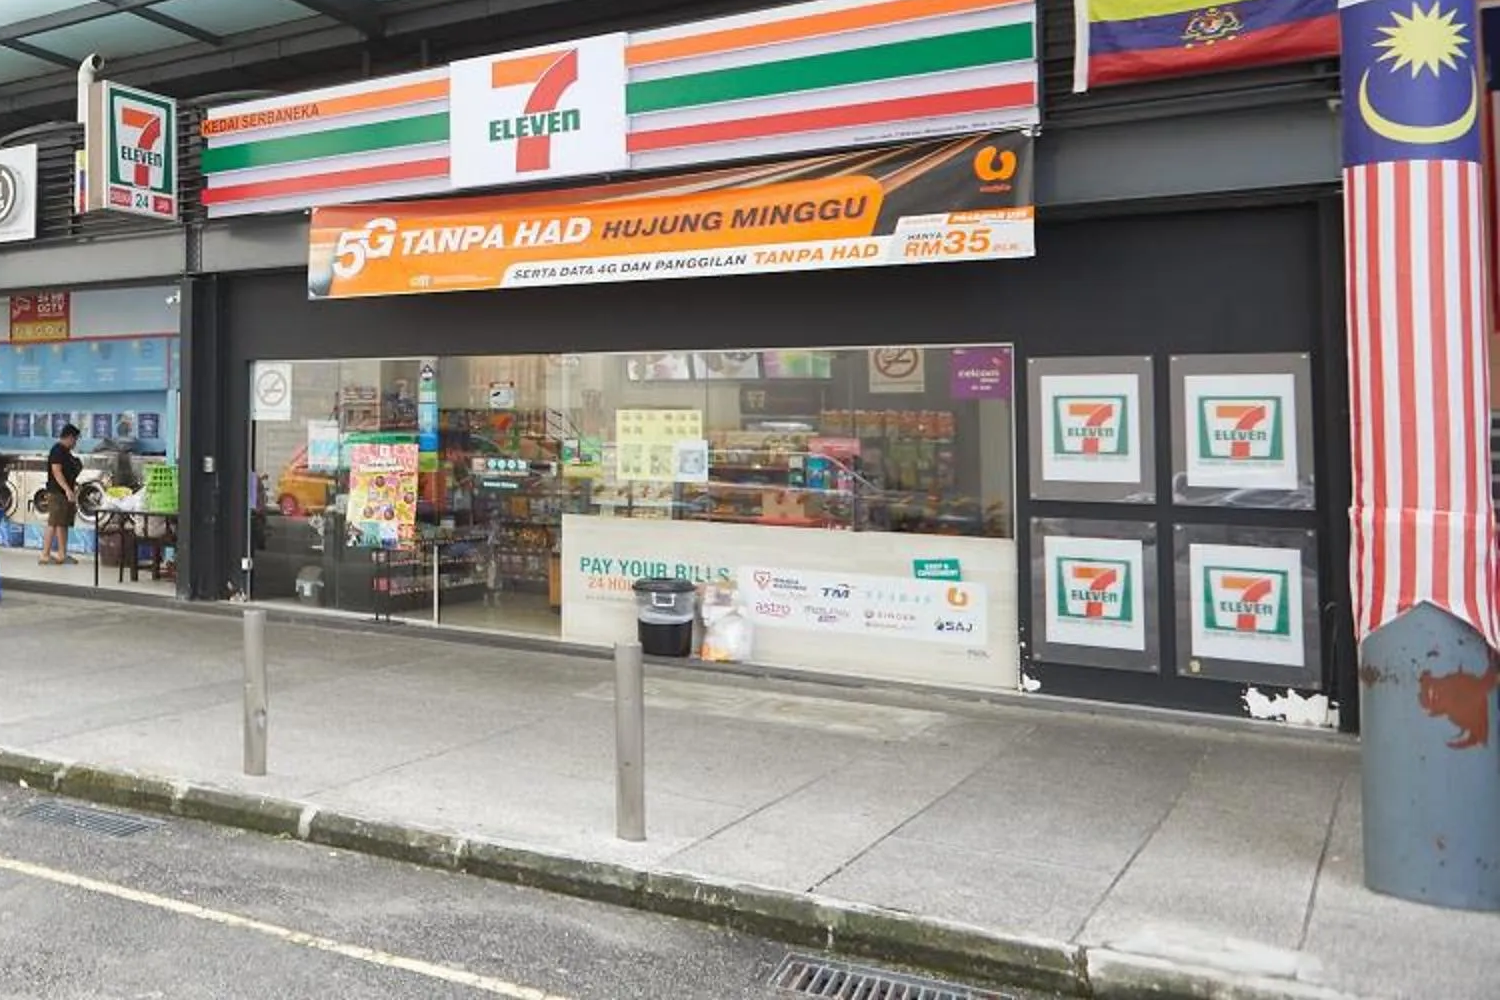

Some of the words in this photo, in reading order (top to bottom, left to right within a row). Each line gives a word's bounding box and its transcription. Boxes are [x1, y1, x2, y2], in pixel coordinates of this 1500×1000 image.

[202, 118, 240, 135] KEDAI
[241, 103, 320, 130] SERBANEKA
[491, 48, 579, 173] 7
[122, 106, 161, 187] 7
[135, 193, 149, 208] 24
[332, 217, 397, 279] 5G
[400, 223, 505, 255] TANPA
[512, 216, 593, 247] HAD
[601, 210, 723, 240] HUJUNG
[730, 195, 868, 229] MINGGU
[514, 267, 557, 280] SERTA
[559, 264, 594, 277] DATA
[597, 262, 618, 275] 4G
[620, 261, 651, 275] DAN
[654, 254, 748, 271] PANGGILAN
[753, 250, 824, 267] TANPA
[829, 242, 880, 261] HAD
[1069, 404, 1114, 456] 7
[1215, 404, 1266, 460] 7
[579, 556, 613, 575] PAY
[618, 559, 667, 579] YOUR
[1072, 567, 1117, 617] 7
[1221, 575, 1272, 632] 7
